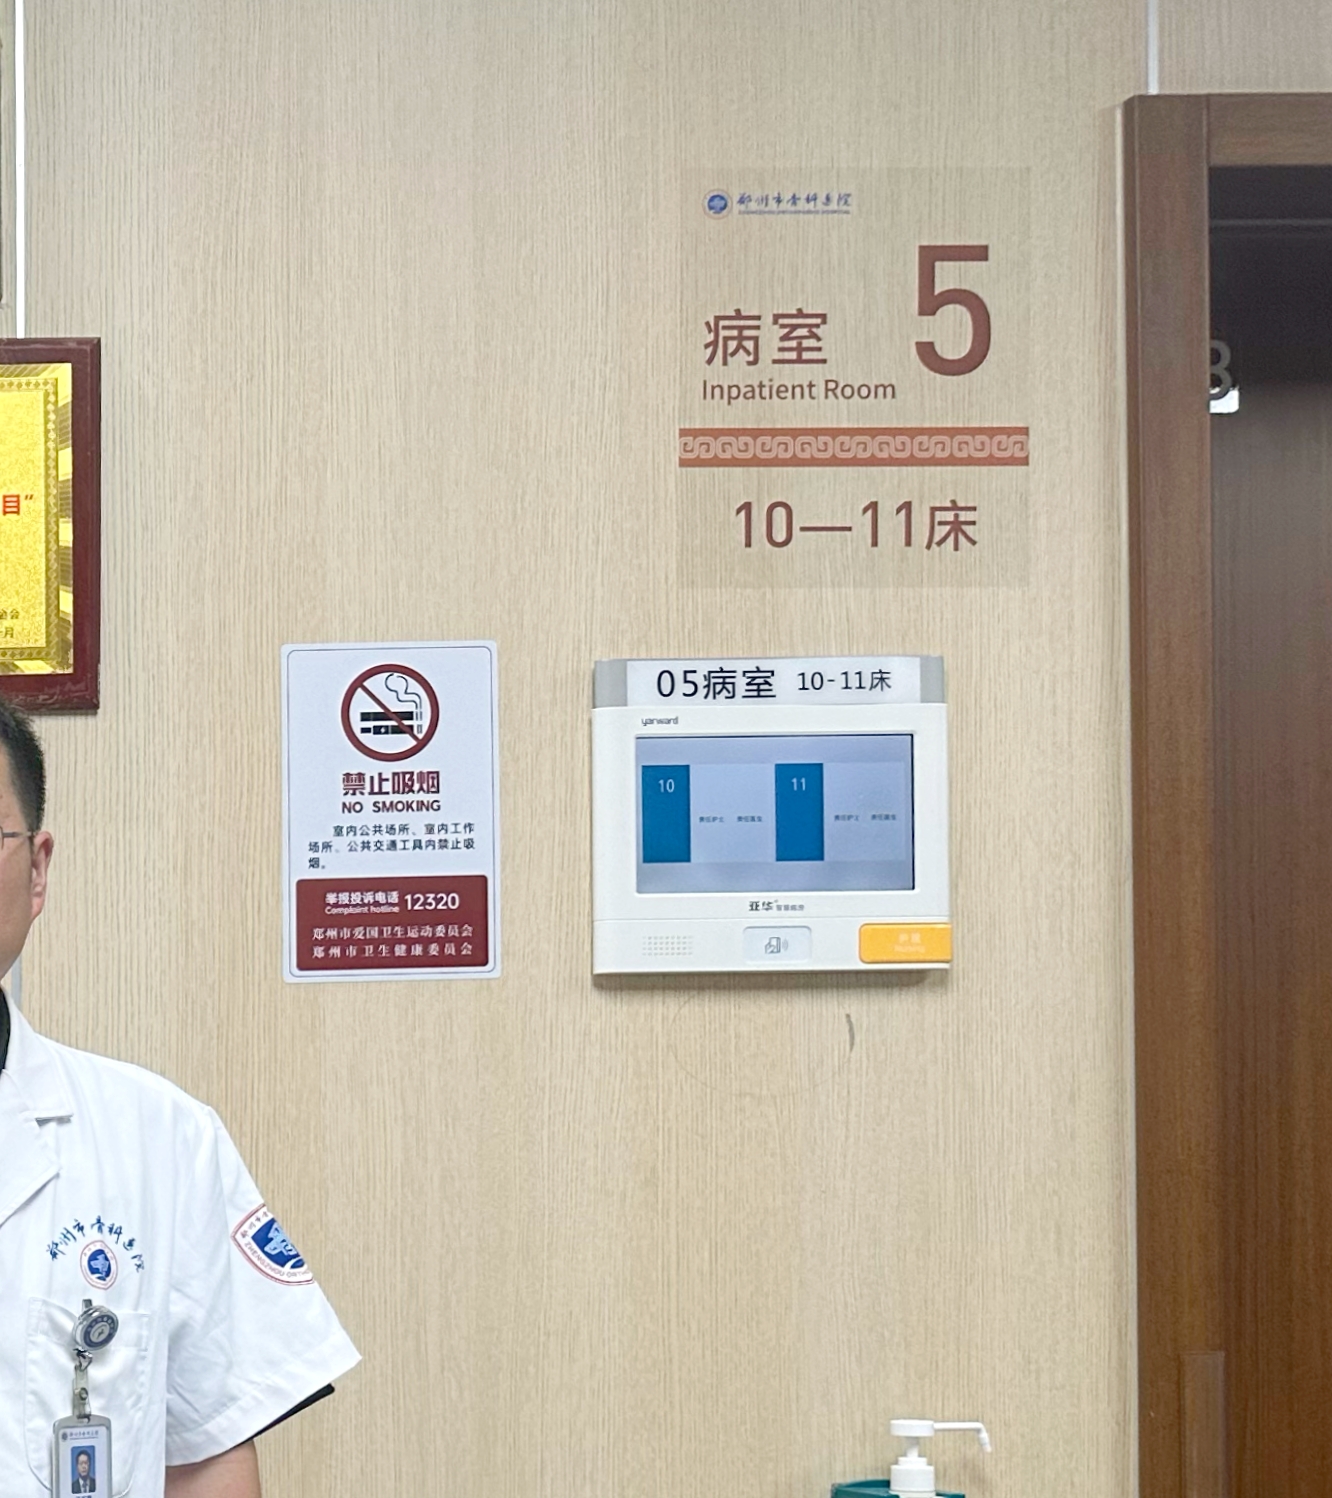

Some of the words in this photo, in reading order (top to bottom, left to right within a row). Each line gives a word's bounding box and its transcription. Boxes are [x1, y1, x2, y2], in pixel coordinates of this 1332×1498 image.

[914, 244, 992, 377] 5
[703, 307, 829, 368] 病室
[701, 378, 816, 406] Inpatient
[823, 378, 897, 401] Room
[656, 665, 777, 700] 05病室
[797, 669, 892, 692] 10-11床
[342, 770, 441, 797] 禁止吸烟
[658, 779, 675, 793] 10
[791, 777, 807, 792] 11
[341, 801, 364, 814] NO
[372, 800, 441, 814] SMOKING
[403, 892, 460, 911] 12320
[312, 923, 474, 941] 郑州市爱国卫生运动委员会
[312, 941, 473, 959] 郑州市卫生健康委员会
